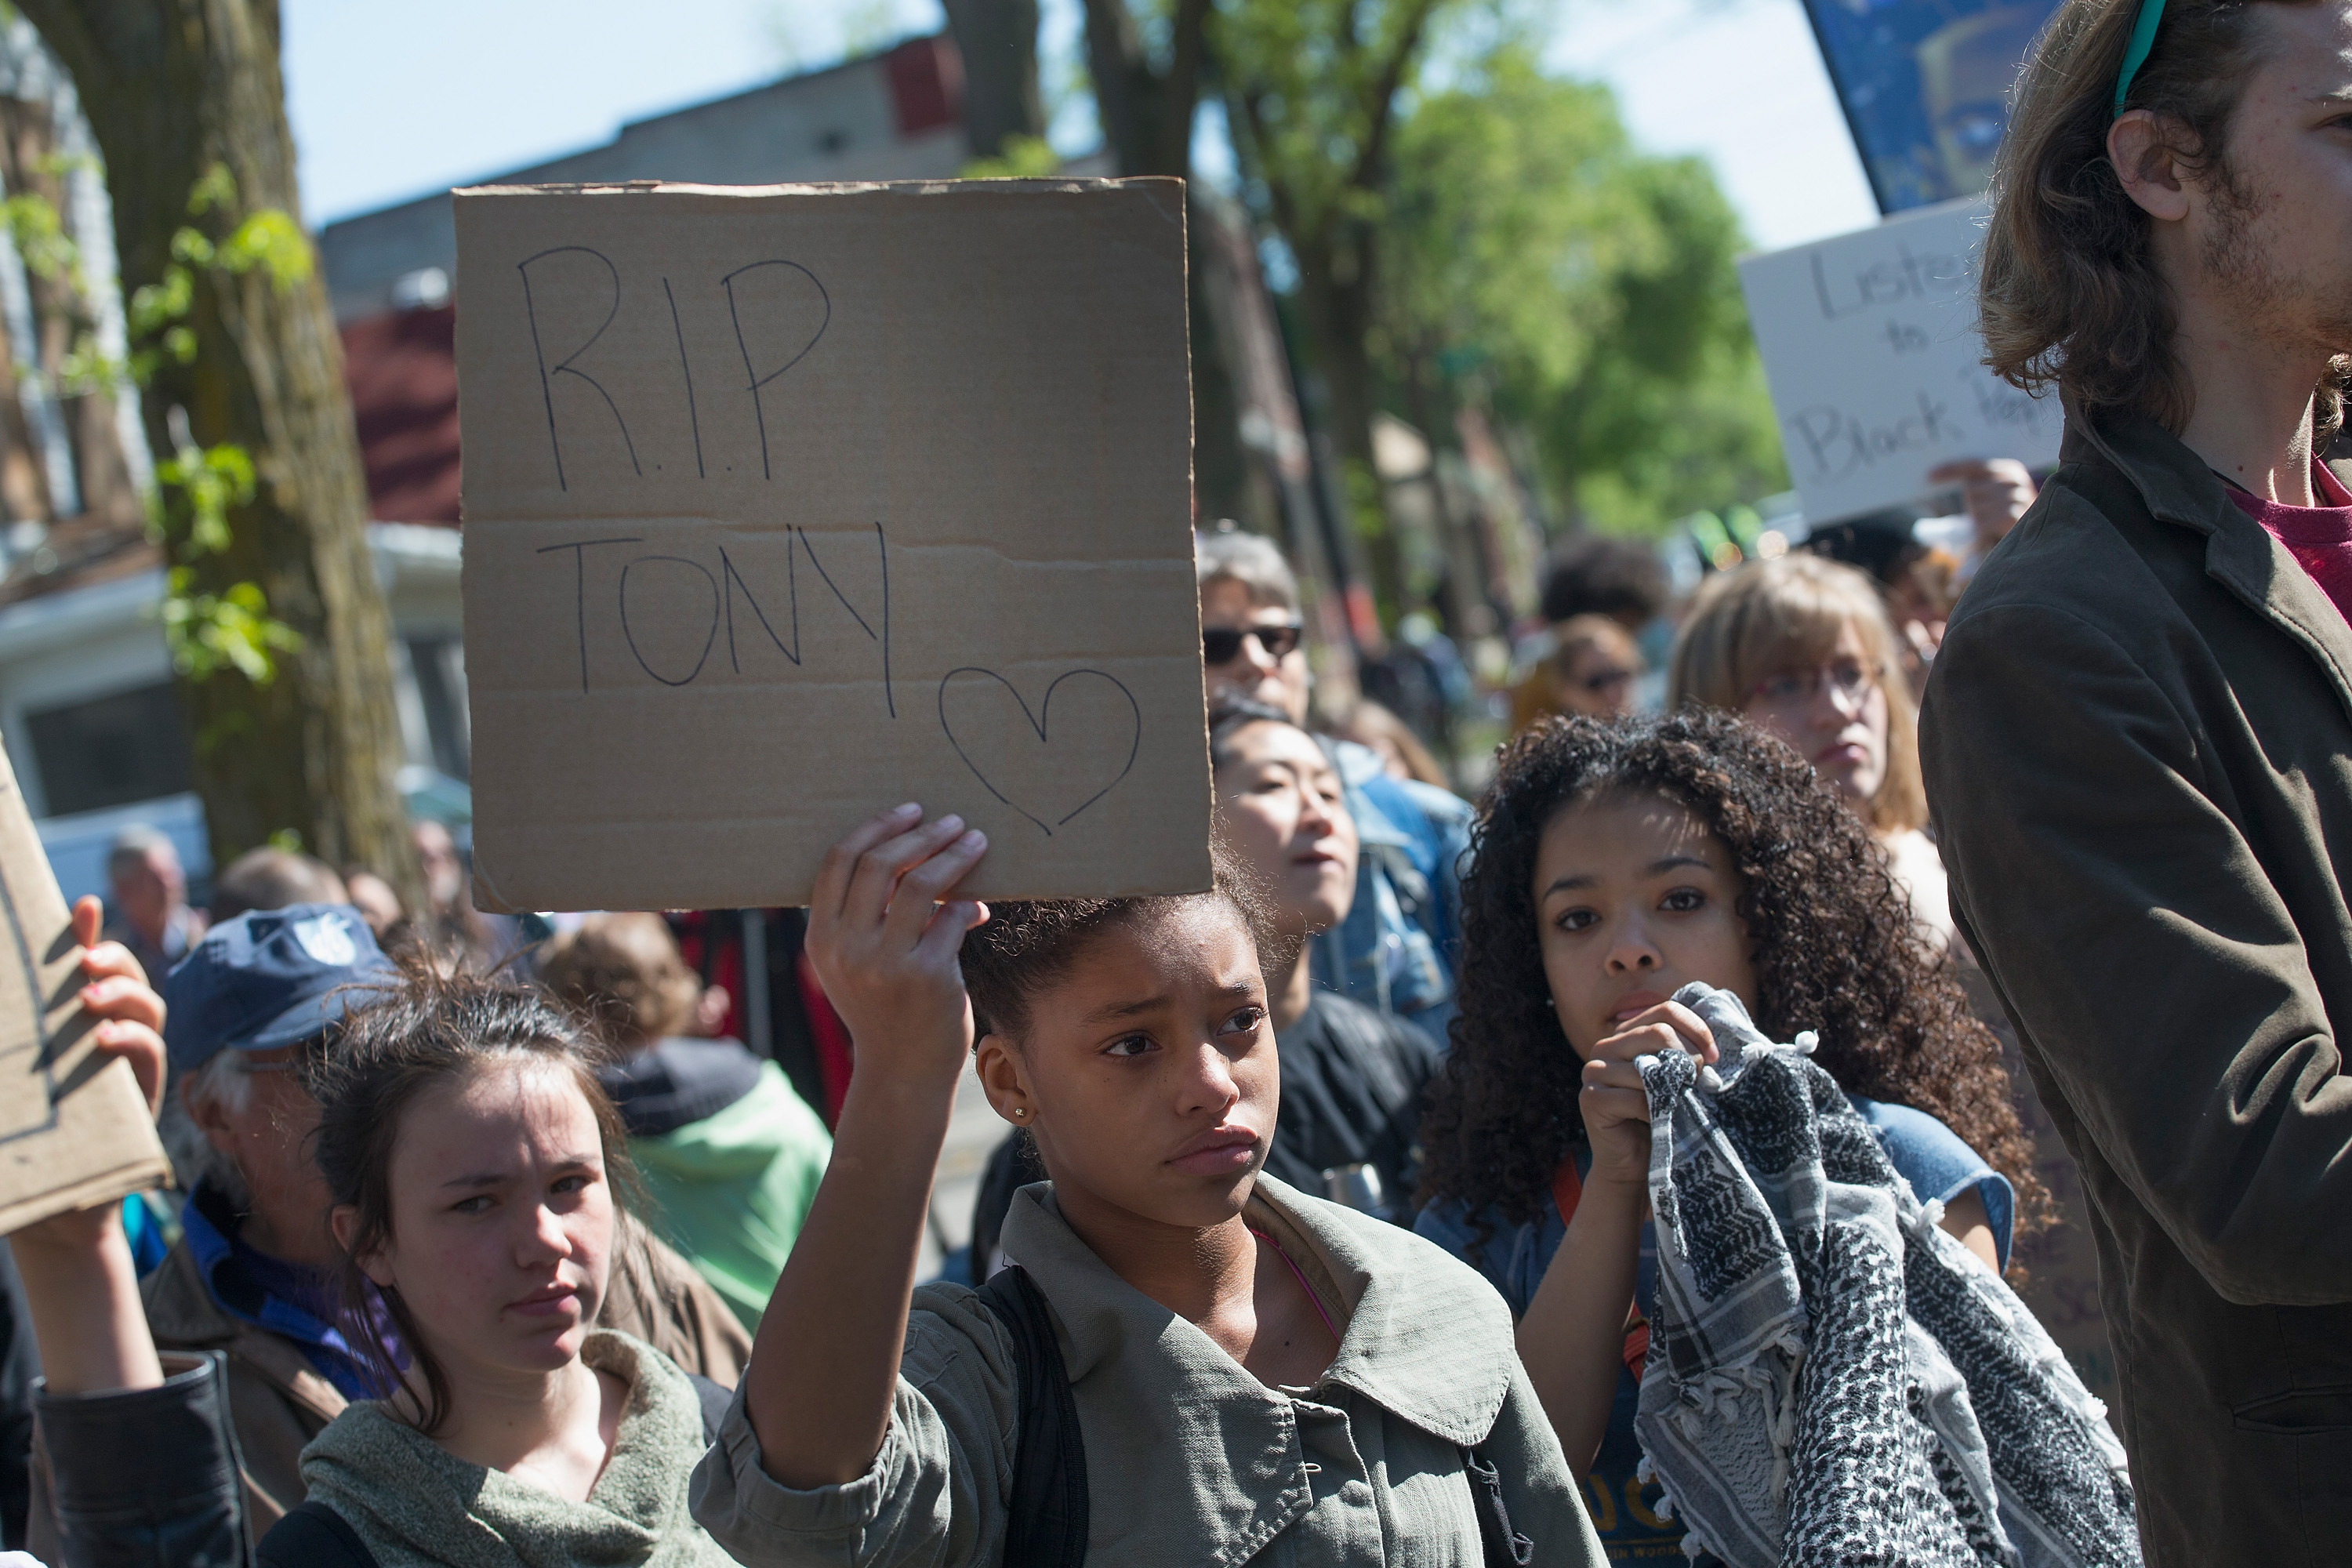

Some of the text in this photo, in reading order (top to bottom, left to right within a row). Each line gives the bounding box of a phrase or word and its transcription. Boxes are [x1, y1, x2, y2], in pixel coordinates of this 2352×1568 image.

[1809, 240, 1977, 321] Liste
[1880, 318, 1931, 357] to
[1786, 388, 1966, 485] Black
[536, 521, 895, 719] TONY
